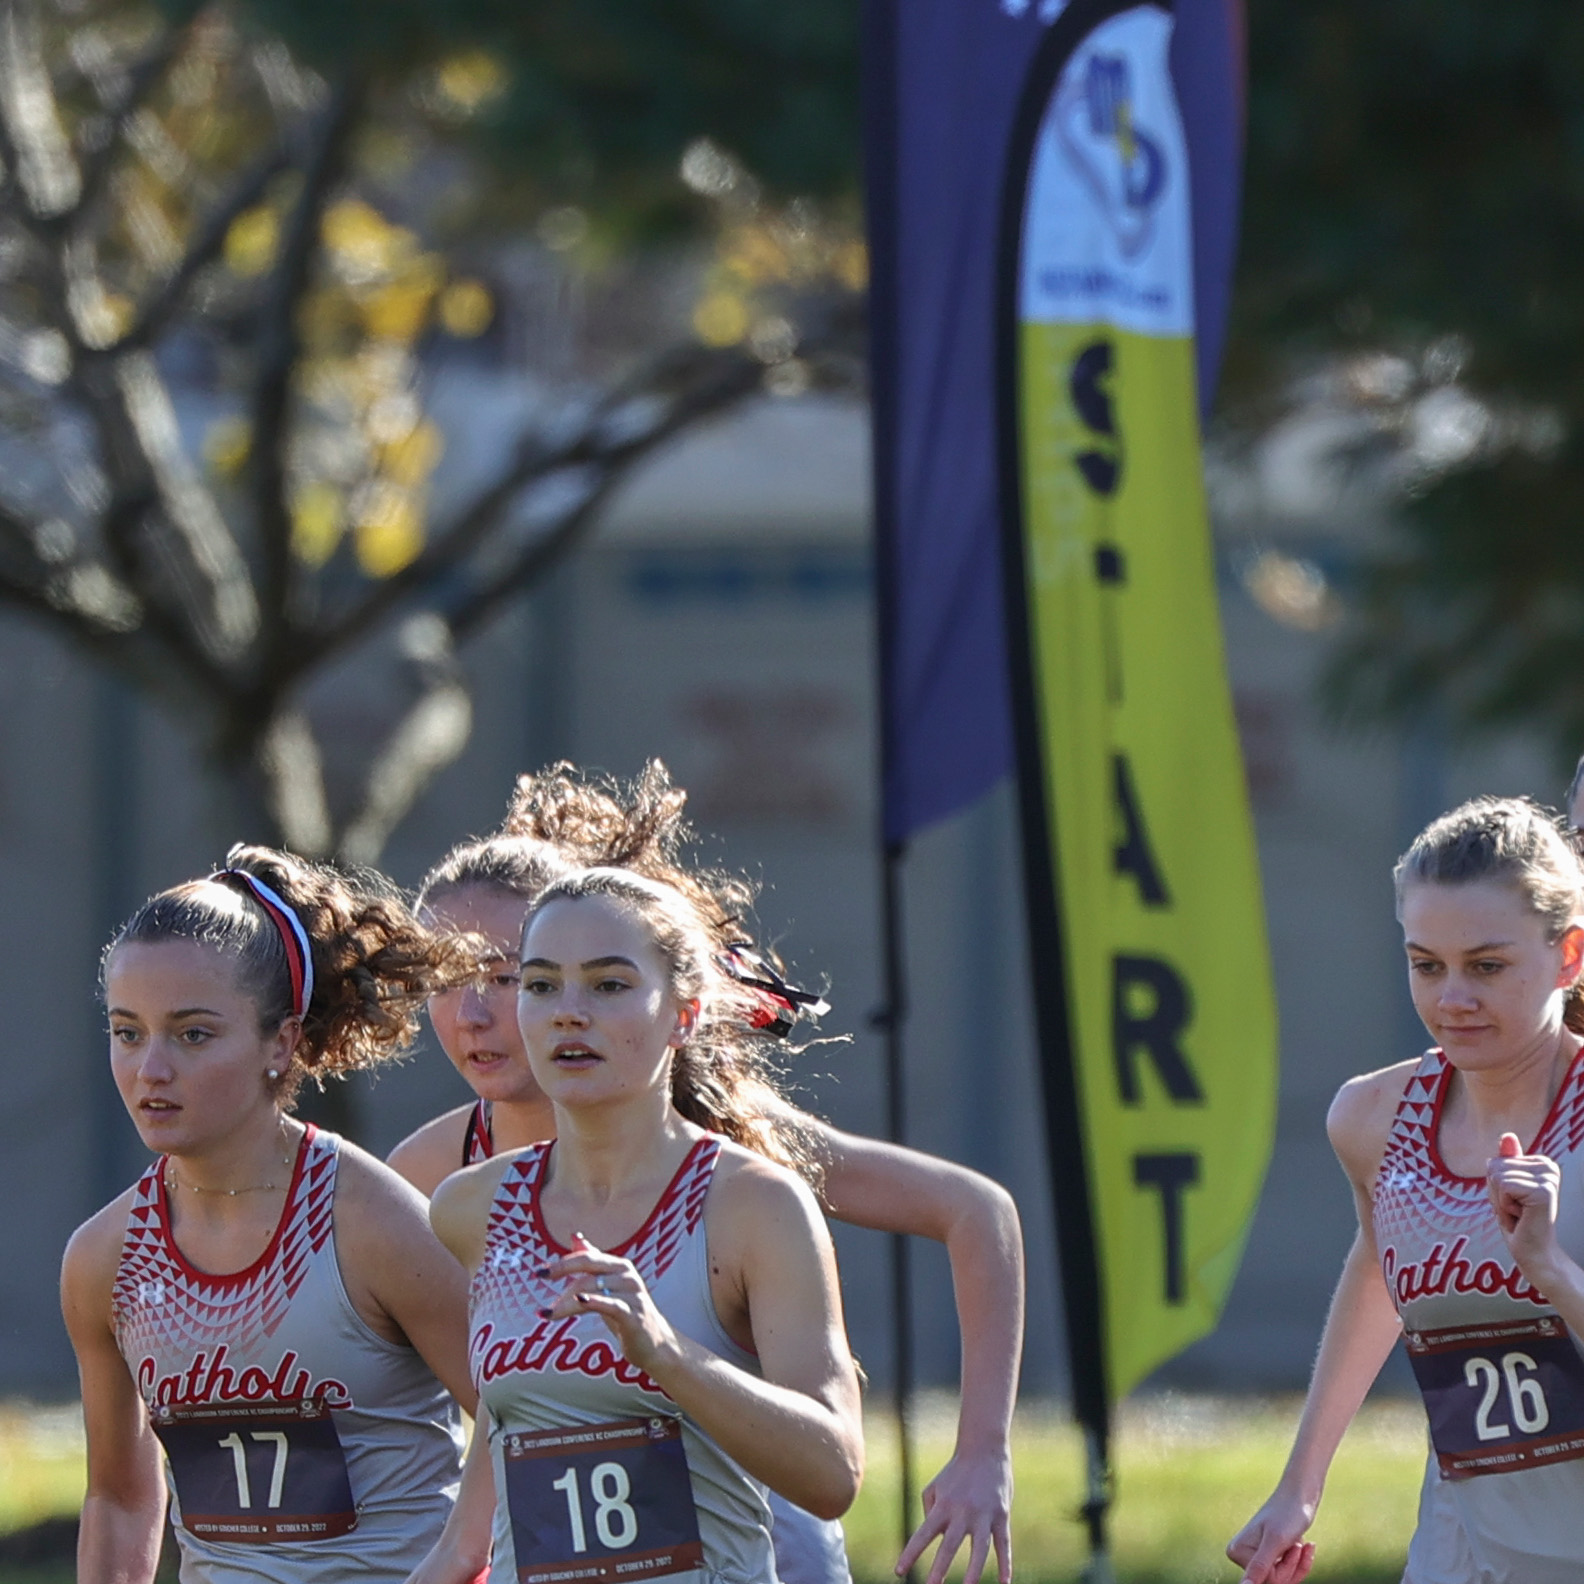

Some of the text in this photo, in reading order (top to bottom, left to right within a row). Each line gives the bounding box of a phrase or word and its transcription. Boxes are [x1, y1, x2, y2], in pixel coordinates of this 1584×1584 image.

[136, 1343, 354, 1415] Catholic
[1464, 1352, 1549, 1441] 26
[218, 1431, 289, 1509] 17
[553, 1462, 637, 1552] 18
